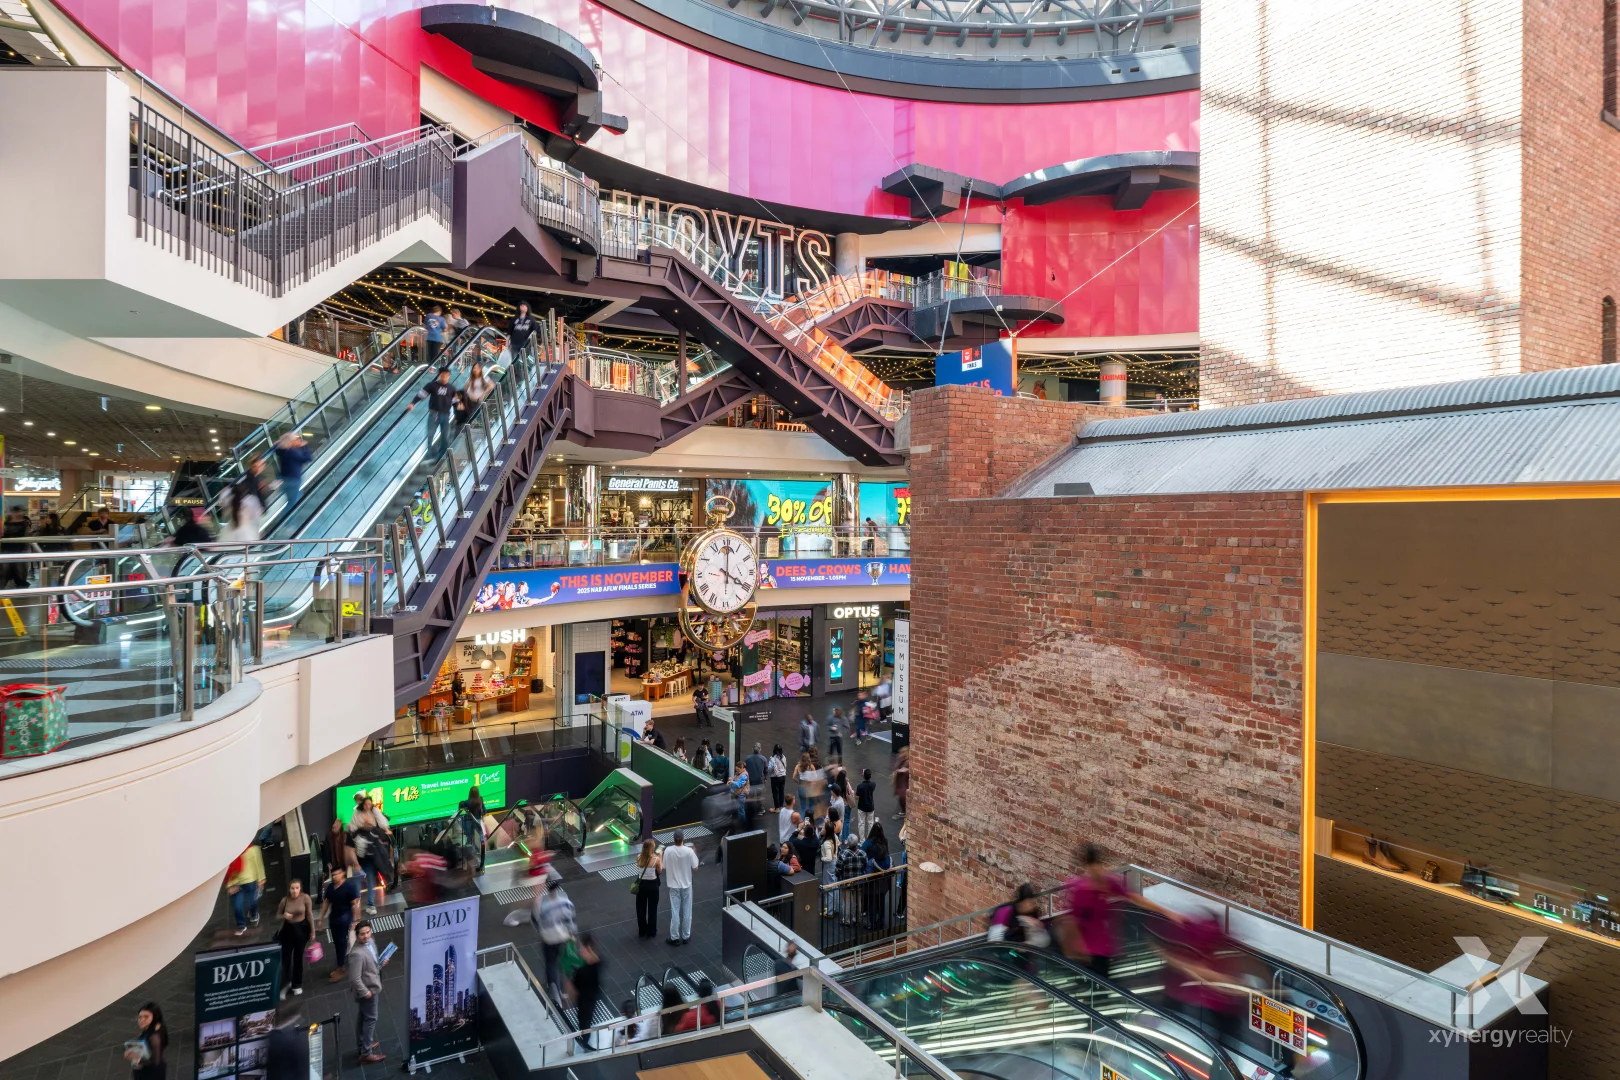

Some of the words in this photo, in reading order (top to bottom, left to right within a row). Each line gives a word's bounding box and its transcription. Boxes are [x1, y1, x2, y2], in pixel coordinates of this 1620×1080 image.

[608, 477, 642, 489] General
[643, 478, 666, 489] Pants
[667, 479, 679, 489] Co.
[768, 493, 806, 525] 30%
[808, 496, 832, 525] OF
[560, 575, 588, 589] THIS
[590, 574, 602, 587] IS
[604, 570, 674, 586] NOVEMBER
[776, 565, 807, 577] DEES
[809, 567, 817, 576] v
[817, 564, 861, 576] CROWS
[834, 606, 880, 618] OPTUS
[475, 628, 526, 645] LUSH
[420, 781, 439, 790] Travel
[440, 777, 469, 787] Insurance
[426, 908, 467, 930] BLVD
[1533, 897, 1591, 923] LITTLE
[212, 959, 265, 985] BLVD
